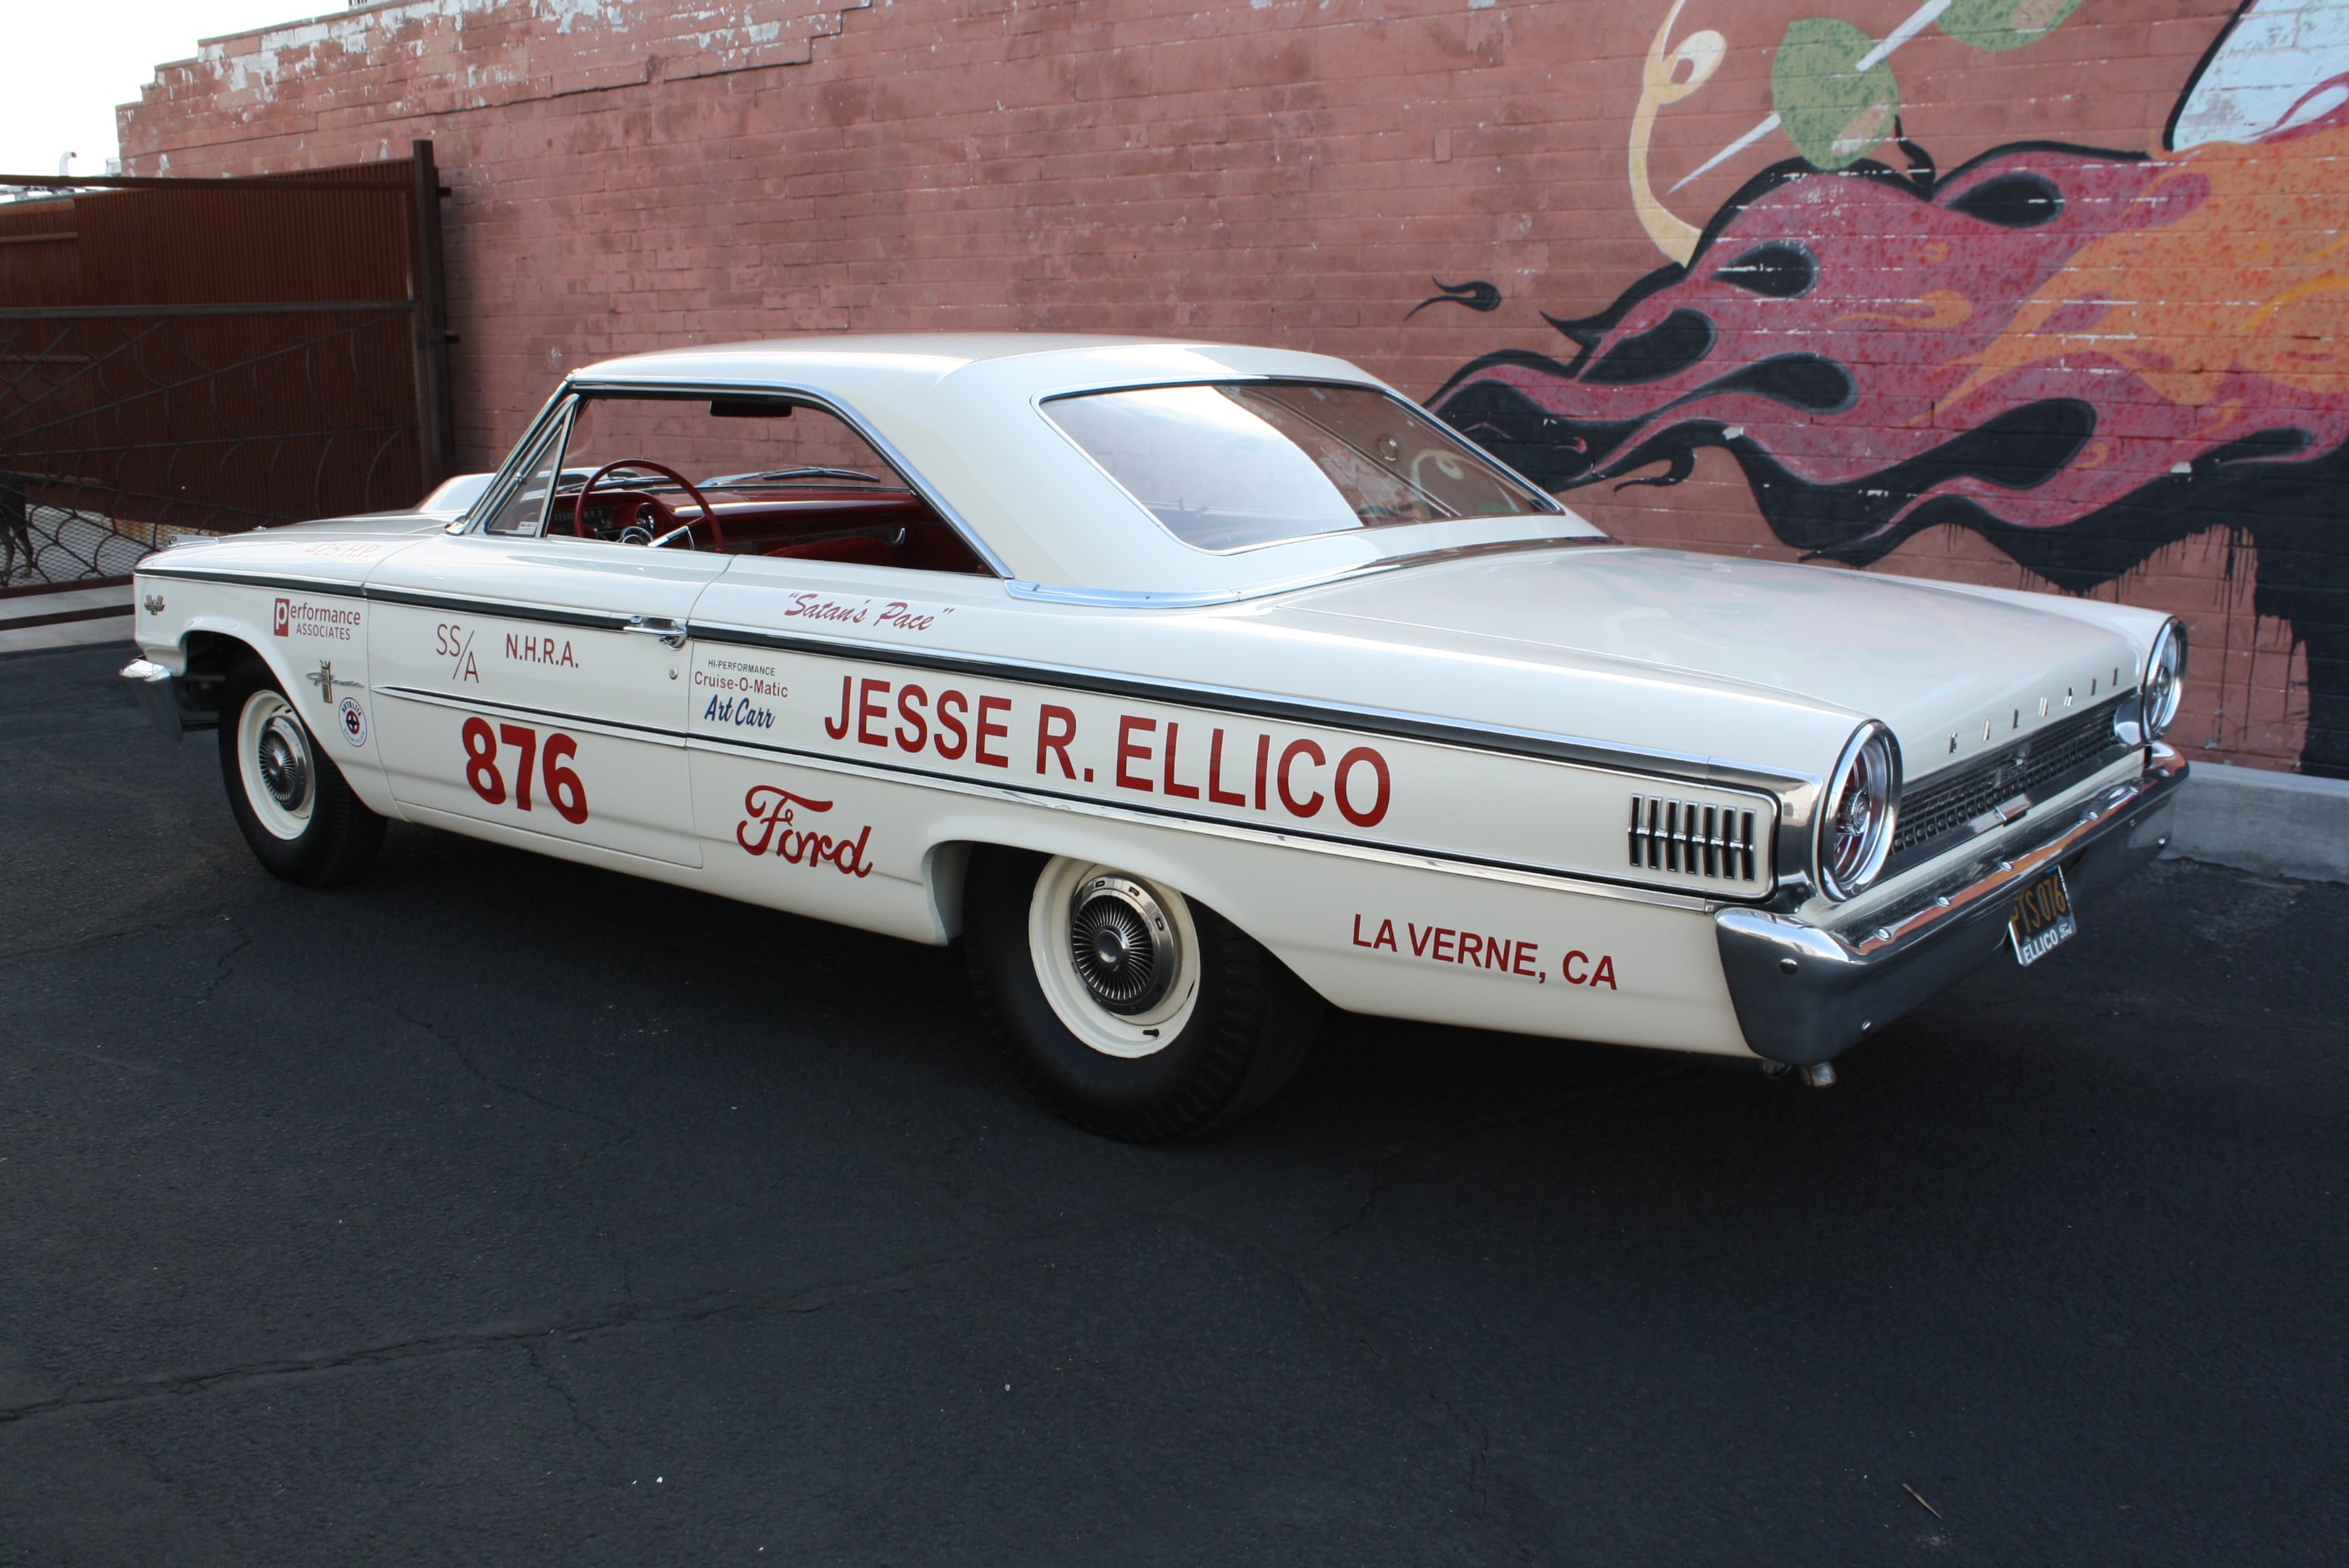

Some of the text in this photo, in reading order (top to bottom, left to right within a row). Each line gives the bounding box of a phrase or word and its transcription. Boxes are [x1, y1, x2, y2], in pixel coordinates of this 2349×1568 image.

[274, 601, 361, 631] performance
[784, 592, 956, 631] "Satan's Pace"
[296, 622, 350, 641] ASSOCIATES
[506, 633, 579, 668] N.H.R.A.
[707, 659, 776, 676] HI-PERFORMANCE
[694, 671, 788, 698] Cruise-O-Matic
[704, 694, 776, 729] Art Carr
[825, 676, 1391, 828] JESSE R. ELLICO
[462, 716, 590, 826] 876
[737, 784, 874, 878] Ford
[1352, 913, 1617, 991] LA VERNE, CA
[2023, 929, 2059, 964] ELLICO
